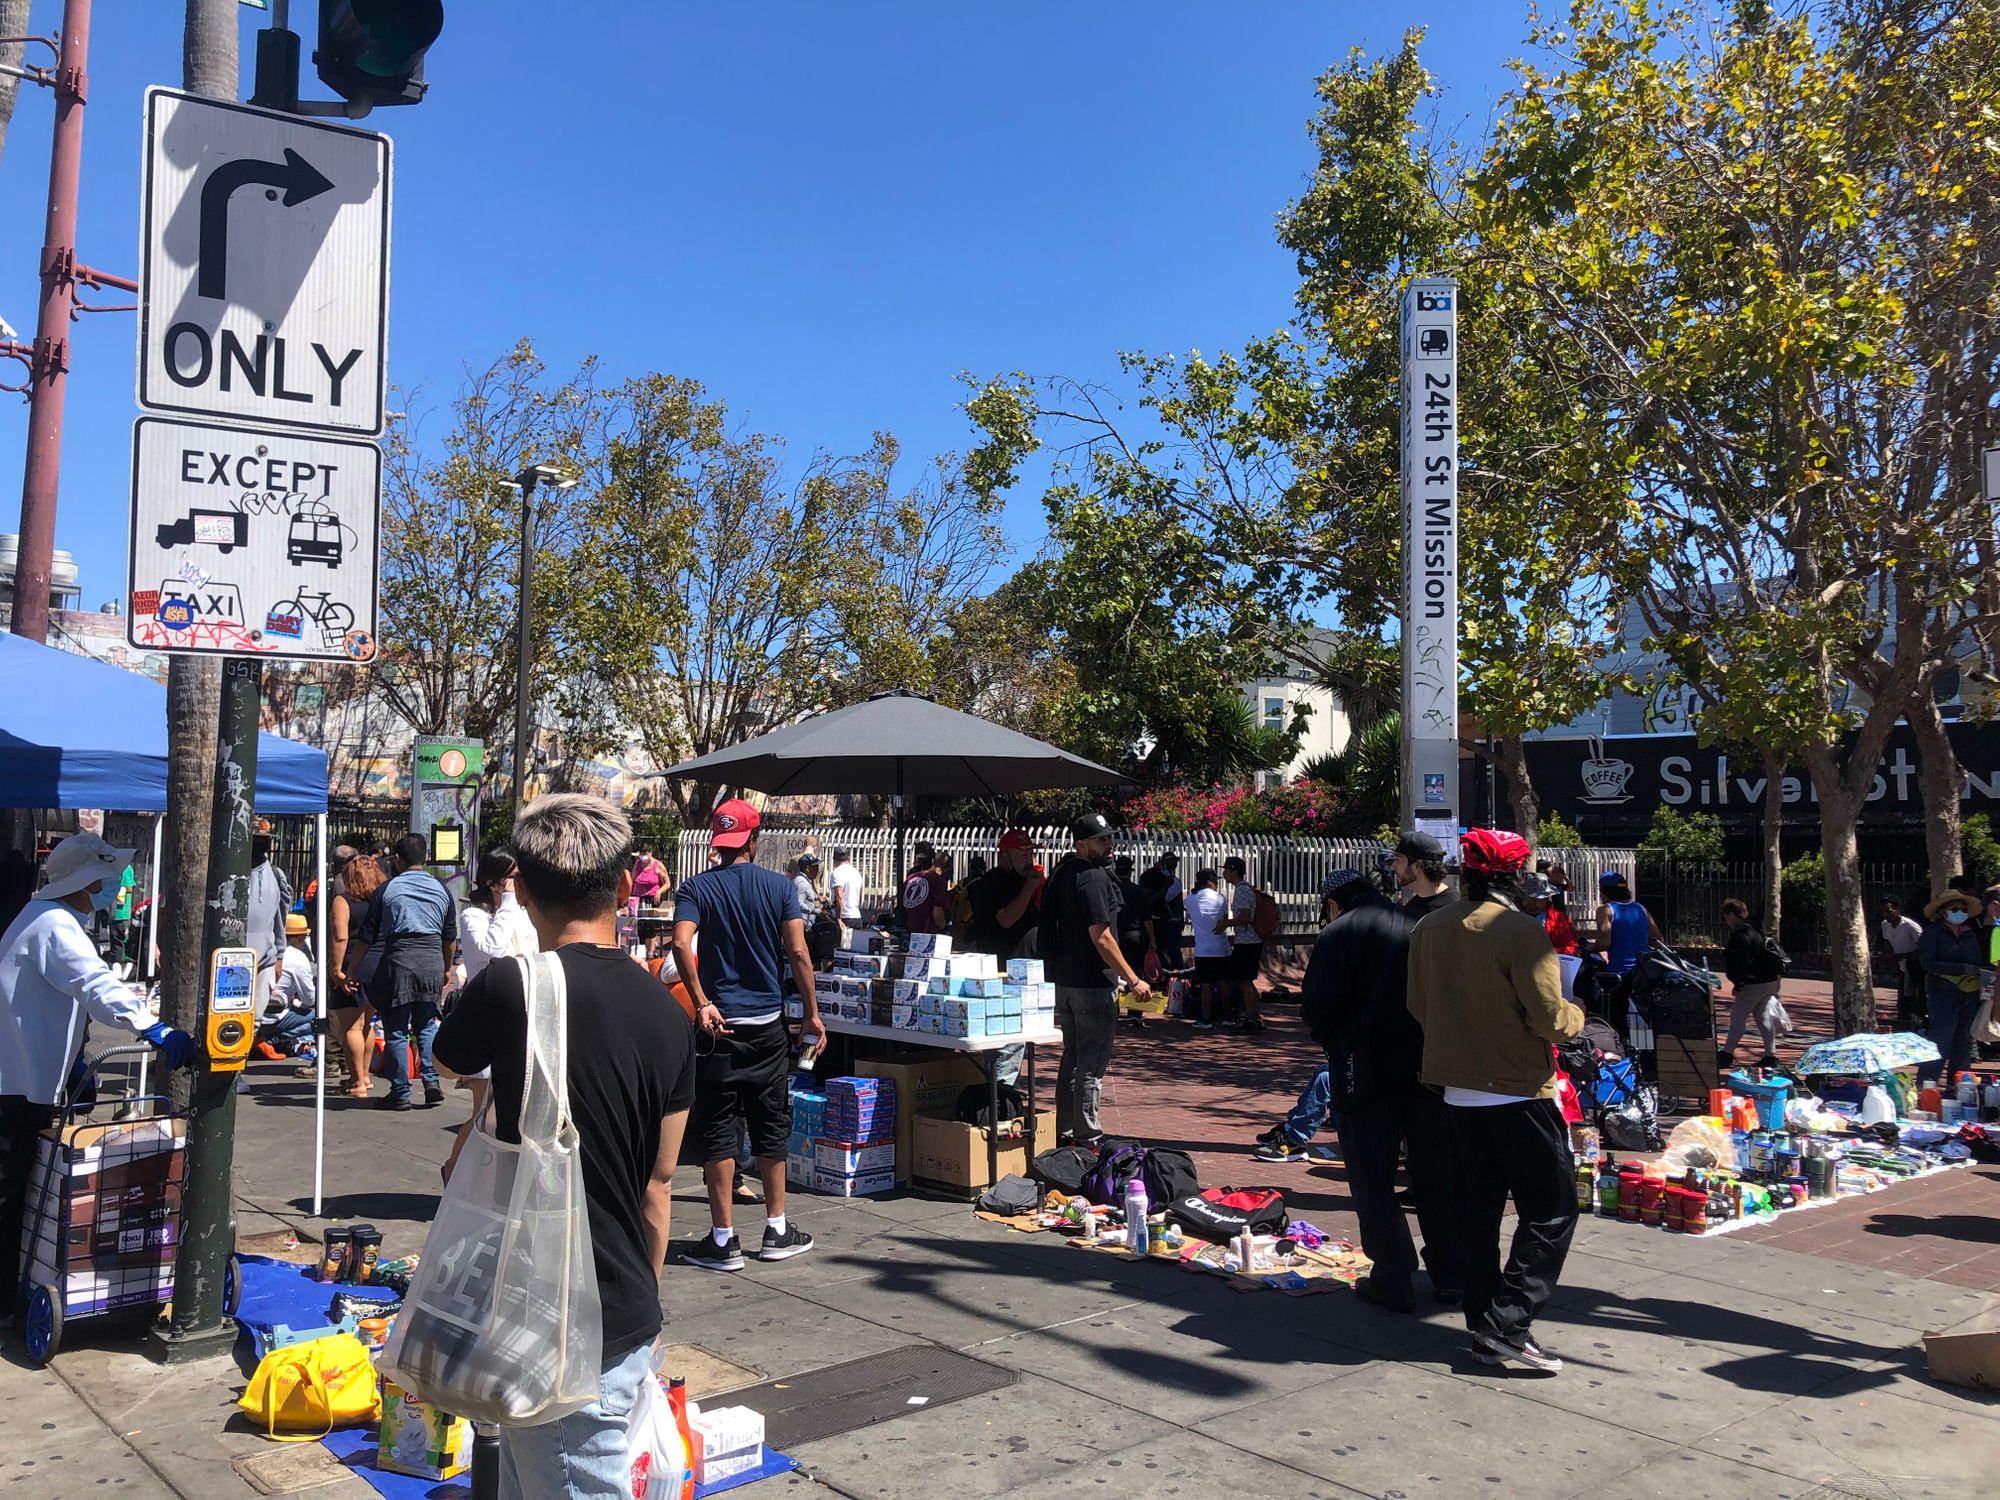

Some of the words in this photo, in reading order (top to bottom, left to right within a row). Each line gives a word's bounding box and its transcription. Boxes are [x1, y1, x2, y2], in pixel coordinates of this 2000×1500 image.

[162, 321, 365, 407] ONLY
[1424, 373, 1452, 442] 24th
[181, 448, 338, 497] EXCEPT
[1424, 455, 1452, 486] St
[1424, 498, 1453, 619] Mission
[1585, 770, 1623, 787] COFFEE
[1184, 1197, 1248, 1224] Champion
